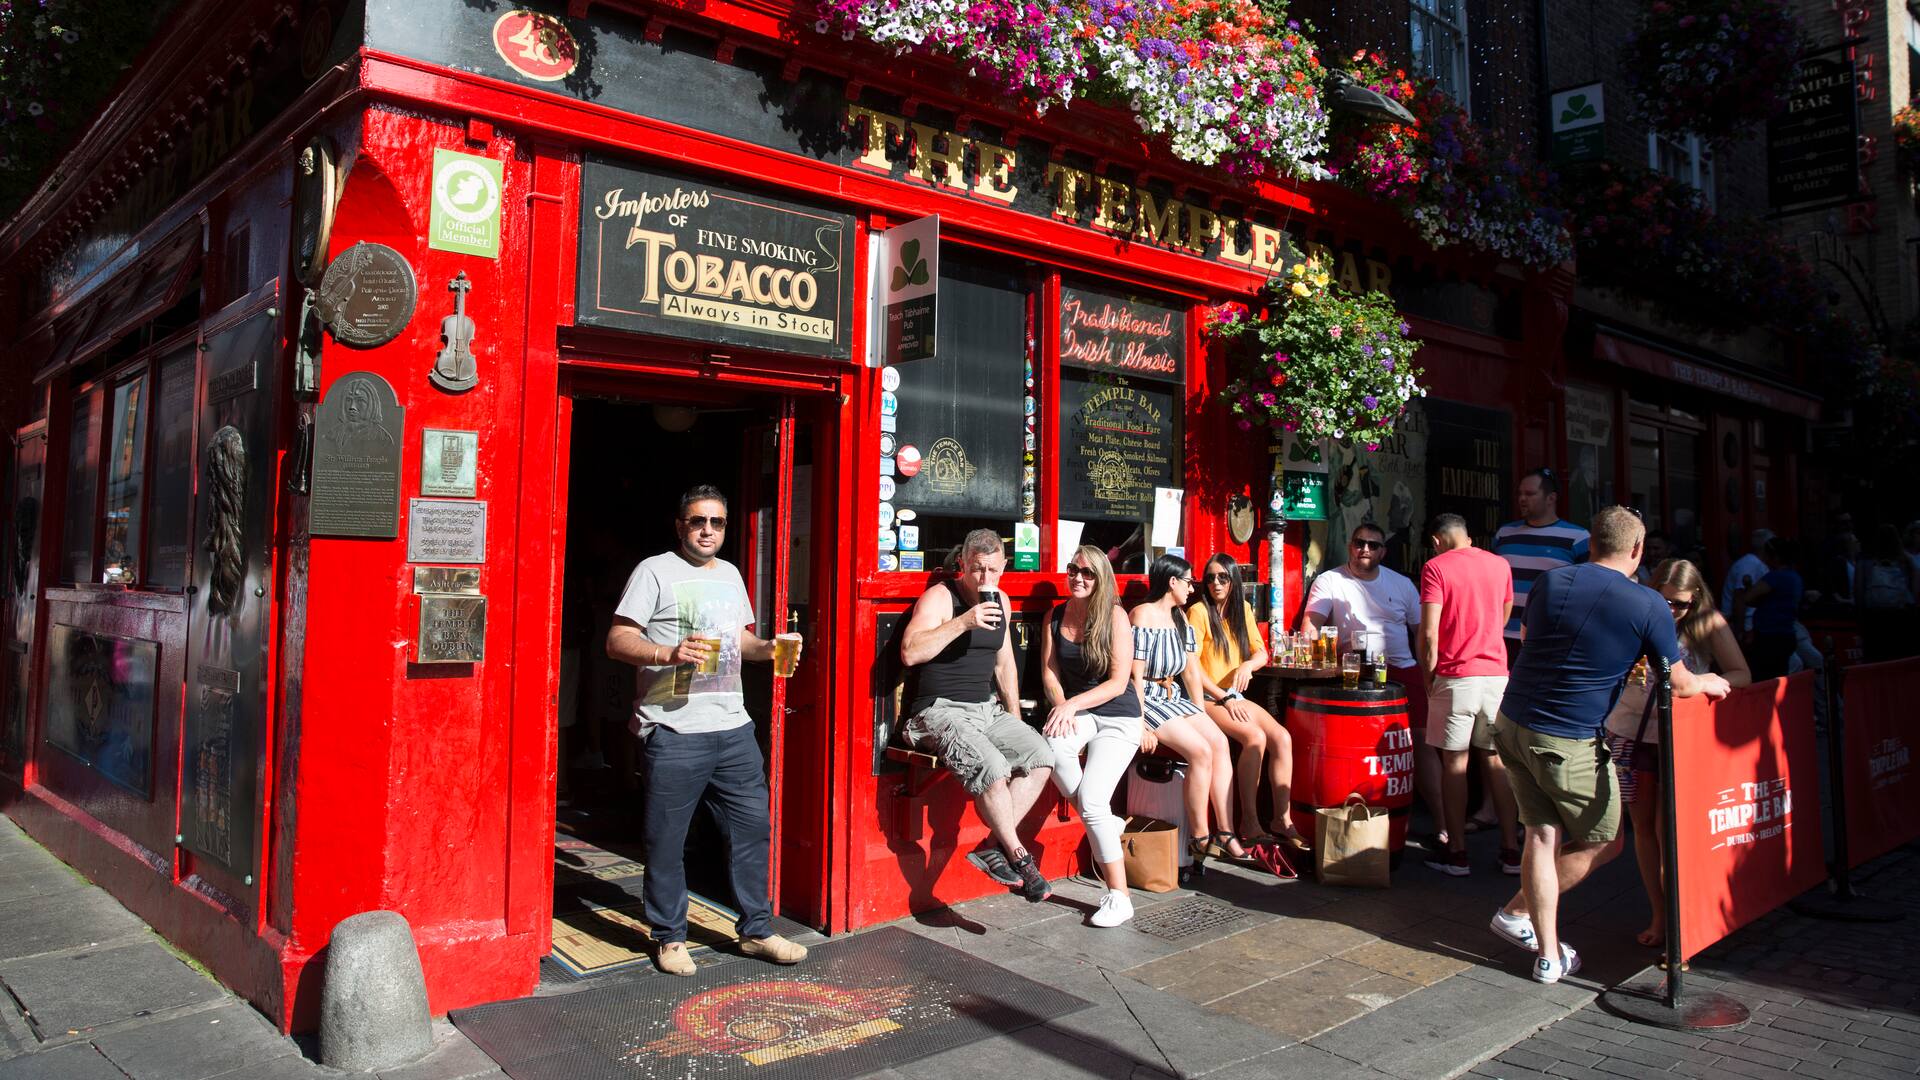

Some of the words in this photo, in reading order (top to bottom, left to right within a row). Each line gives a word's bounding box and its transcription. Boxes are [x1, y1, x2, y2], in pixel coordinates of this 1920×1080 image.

[508, 19, 561, 66] 48
[1788, 92, 1834, 114] BAR
[1775, 171, 1806, 185] LIVE
[1808, 162, 1848, 178] MUSIC
[847, 103, 1019, 206] THE
[1047, 161, 1284, 275] TEMPLE
[1792, 177, 1833, 193] DAILY
[594, 187, 710, 228] Importers
[446, 220, 486, 236] Official
[668, 213, 688, 228] OF
[442, 229, 490, 247] Member
[697, 229, 738, 252] FINE
[741, 238, 818, 267] SMOKING
[625, 226, 818, 312] TOBACCO
[667, 296, 740, 322] Always
[752, 309, 769, 326] in
[778, 312, 831, 336] Stock
[1064, 300, 1172, 337] Traditional
[1060, 329, 1112, 364] Irish
[1119, 341, 1176, 374] Music
[1118, 377, 1129, 386] The
[1085, 387, 1136, 414] TEMPLE
[1139, 394, 1161, 423] BAR
[1084, 415, 1124, 430] Traditional
[1127, 421, 1144, 433] Food
[1146, 424, 1161, 434] Fare
[930, 451, 938, 465] THE
[936, 440, 959, 451] TEMPLE
[1088, 433, 1104, 443] Meat
[1123, 436, 1142, 448] Cheese
[1143, 439, 1161, 450] Board
[1080, 445, 1097, 457] Fresh
[1123, 450, 1146, 462] Smoked
[1146, 453, 1168, 464] Salmon
[1473, 438, 1500, 468] THE
[1144, 467, 1161, 477] Olives
[1441, 466, 1500, 501] EMPEROR
[1125, 490, 1138, 501] Beef
[1140, 493, 1154, 503] Rolls
[903, 530, 915, 538] tax
[430, 579, 465, 589] Ashtray
[433, 619, 477, 629] TEMPLE
[442, 608, 465, 618] THE
[432, 641, 475, 651] DUBLIN
[442, 630, 465, 640] BAR
[1362, 751, 1414, 776] TEMP
[1740, 780, 1769, 802] THE
[1708, 800, 1771, 835] TEMPLE
[1726, 832, 1755, 847] DUBLIN
[1760, 824, 1783, 840] IRELAND
